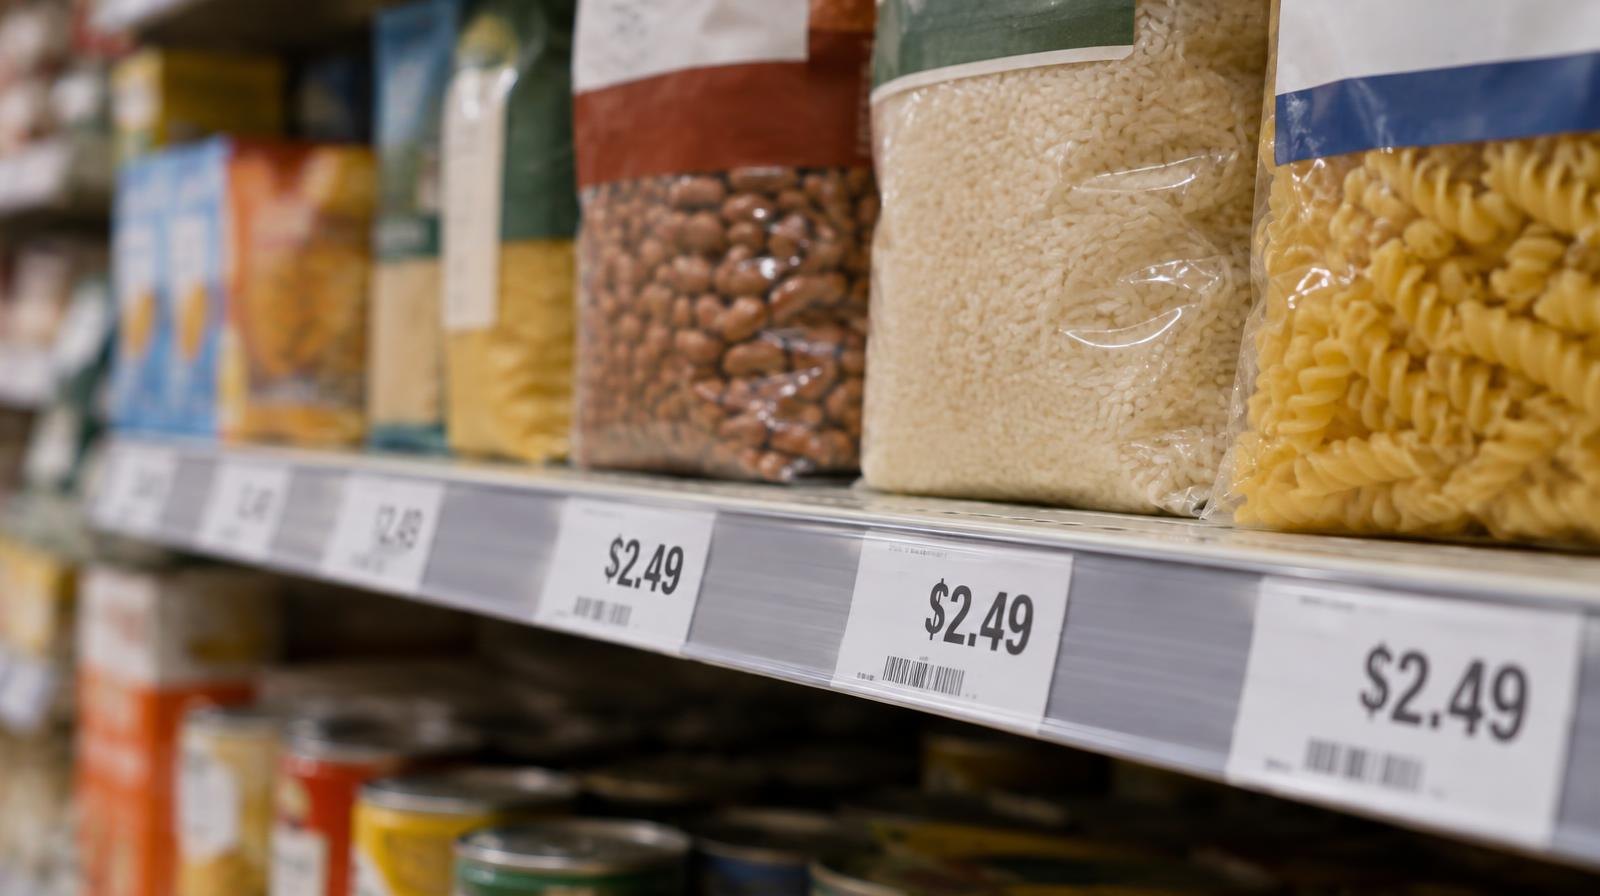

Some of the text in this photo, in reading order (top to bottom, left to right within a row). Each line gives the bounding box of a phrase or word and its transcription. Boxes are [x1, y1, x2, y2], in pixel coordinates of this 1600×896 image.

[605, 535, 684, 595] $2.49
[925, 578, 1034, 655] $2.49
[1360, 645, 1528, 742] $2.49
